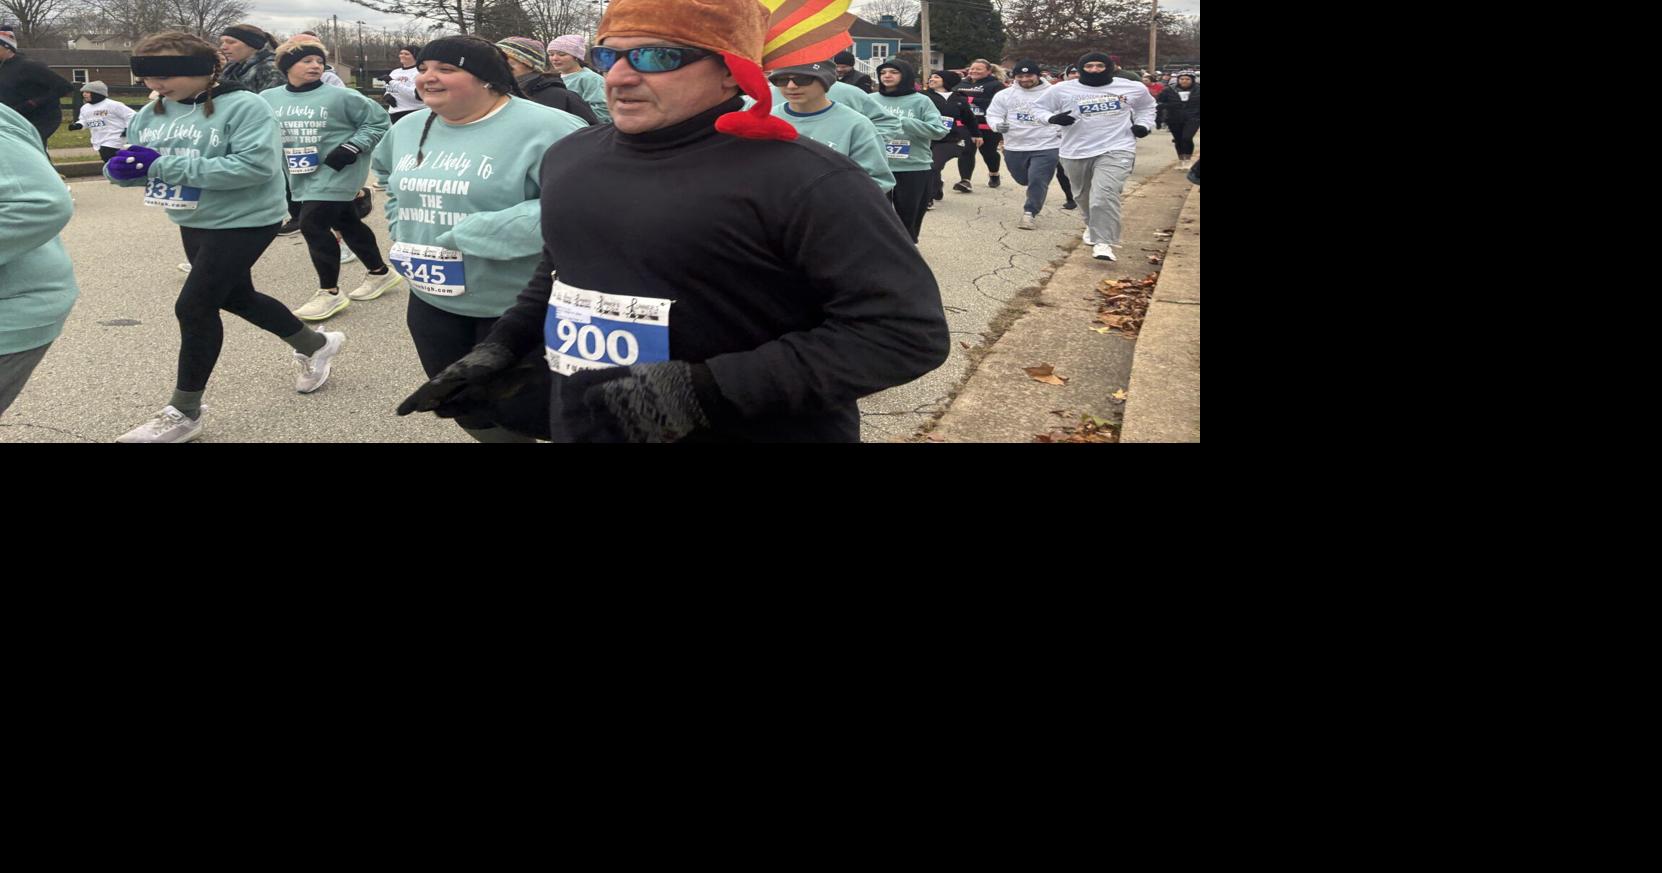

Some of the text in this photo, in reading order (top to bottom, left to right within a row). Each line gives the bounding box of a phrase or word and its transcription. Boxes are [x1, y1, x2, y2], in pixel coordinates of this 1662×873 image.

[287, 105, 315, 119] Likely
[320, 106, 328, 119] To
[1082, 102, 1117, 113] 2485
[284, 120, 327, 128] EVERYONE
[301, 128, 318, 136] THE
[138, 122, 222, 147] Most Likely To
[300, 135, 322, 143] TROT
[431, 150, 471, 177] Likely
[477, 154, 494, 180] To
[145, 181, 183, 201] 331
[399, 177, 470, 195] COMPLAIN
[419, 193, 443, 209] THE
[401, 261, 446, 285] 345
[557, 319, 639, 366] 900
